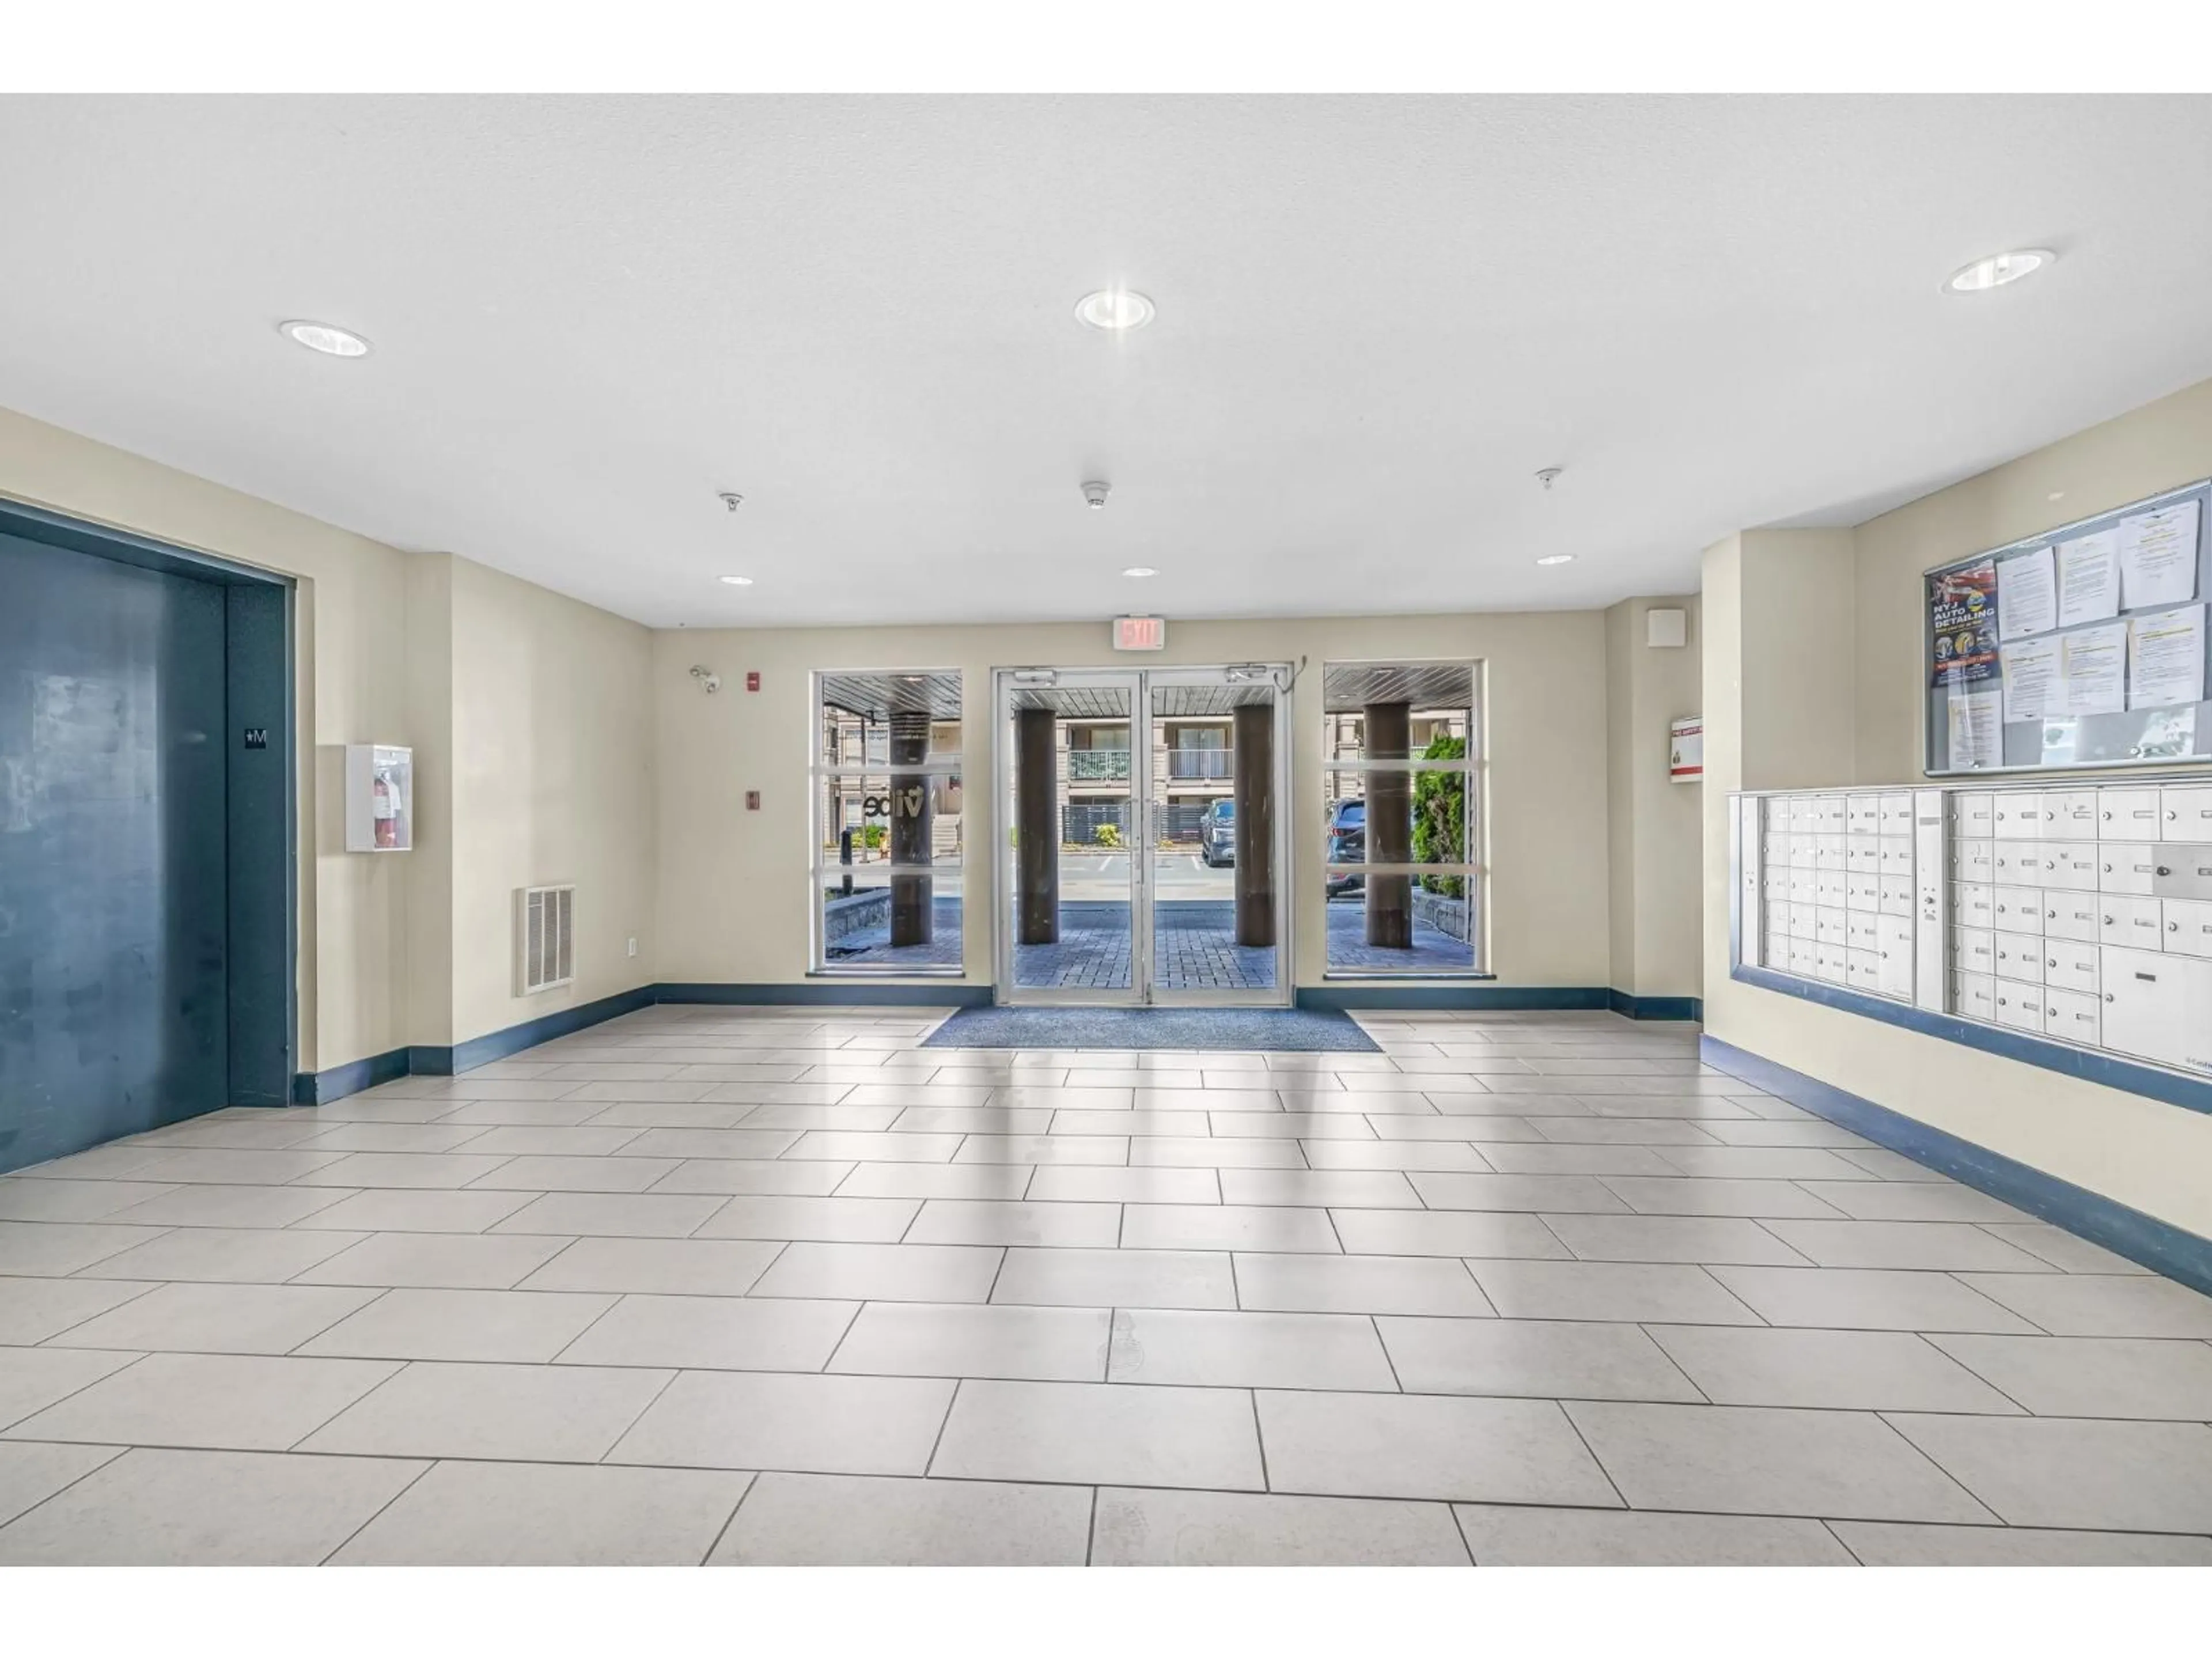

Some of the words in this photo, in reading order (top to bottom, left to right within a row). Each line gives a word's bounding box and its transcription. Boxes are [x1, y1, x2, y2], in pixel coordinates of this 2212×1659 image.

[1934, 601, 1958, 612] NYJ
[1935, 608, 1965, 620] AUTO
[1936, 608, 1995, 628] DETAILING
[1122, 619, 1158, 646] EXIT
